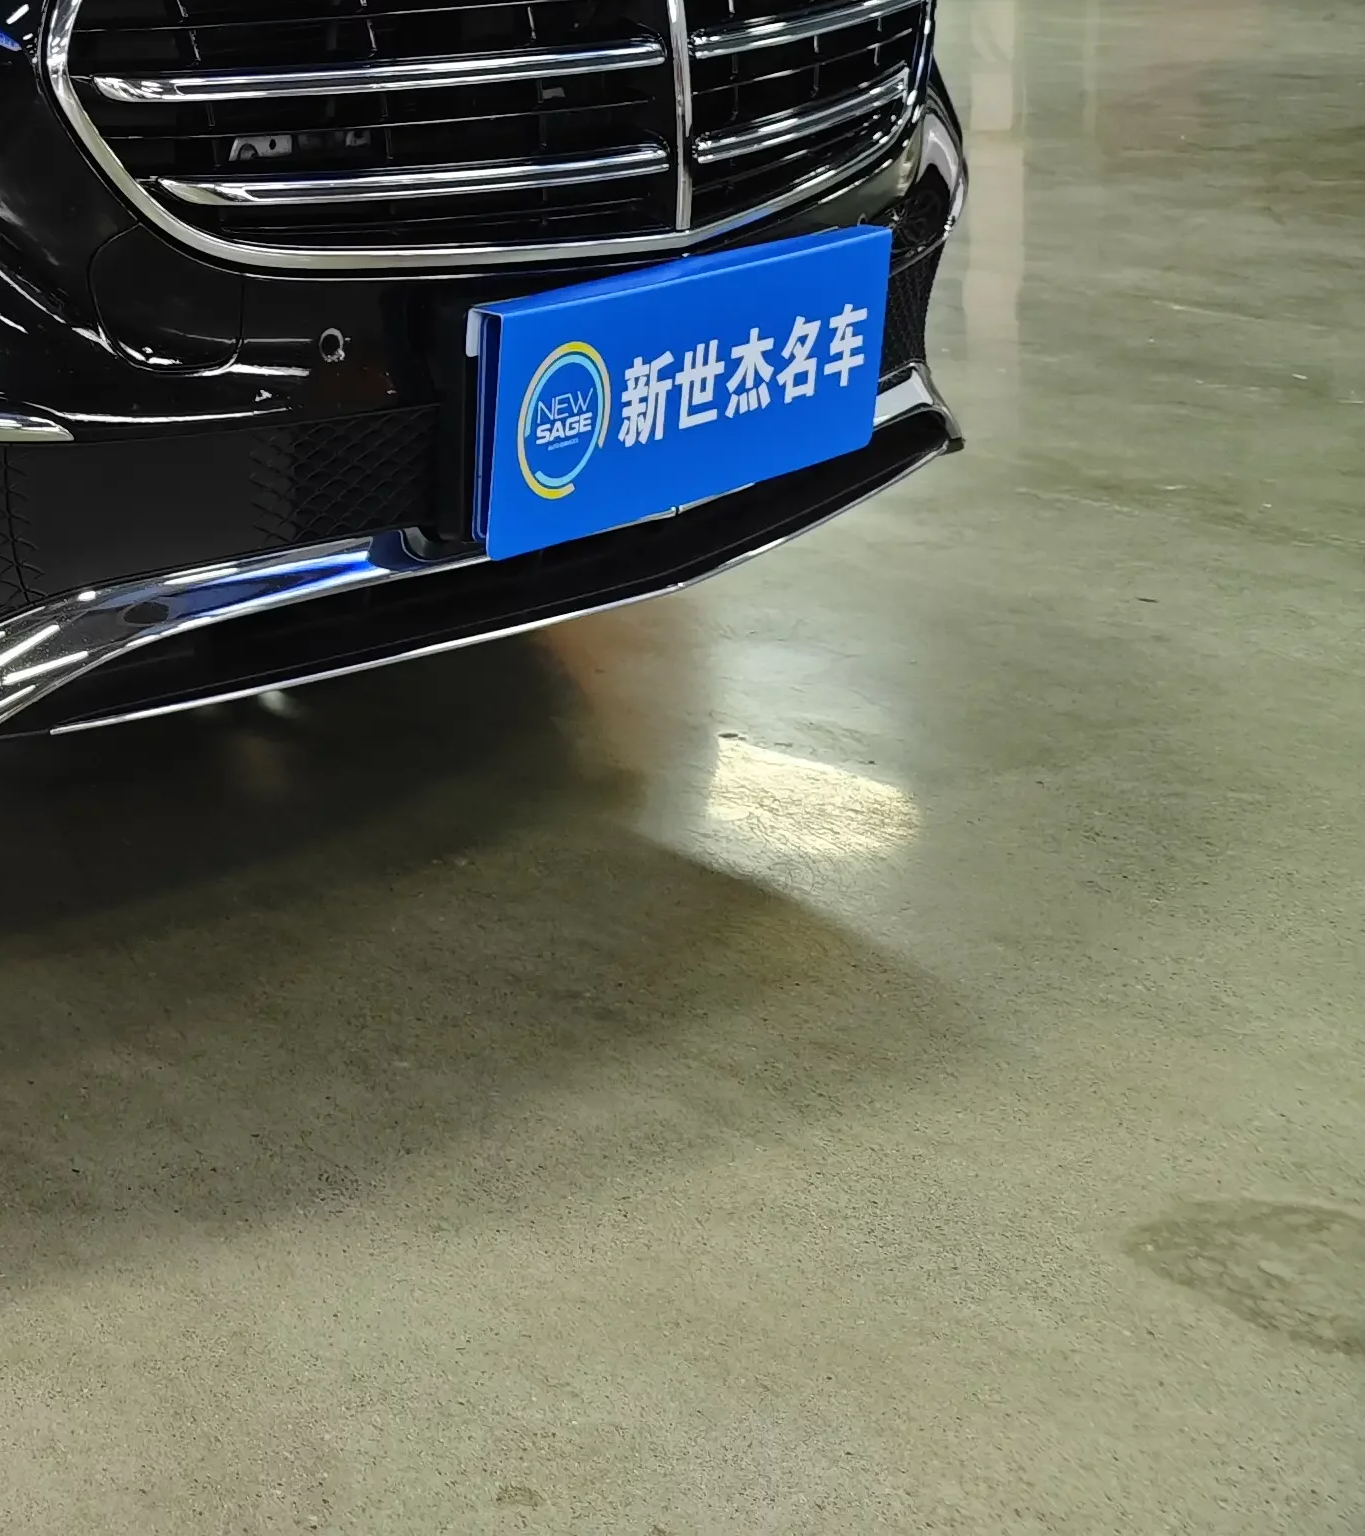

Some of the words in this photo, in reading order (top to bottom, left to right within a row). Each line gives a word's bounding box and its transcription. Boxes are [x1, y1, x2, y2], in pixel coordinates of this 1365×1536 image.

[617, 303, 869, 449] 新世杰名车
[536, 387, 594, 425] NEW
[535, 411, 594, 446] SAGE
